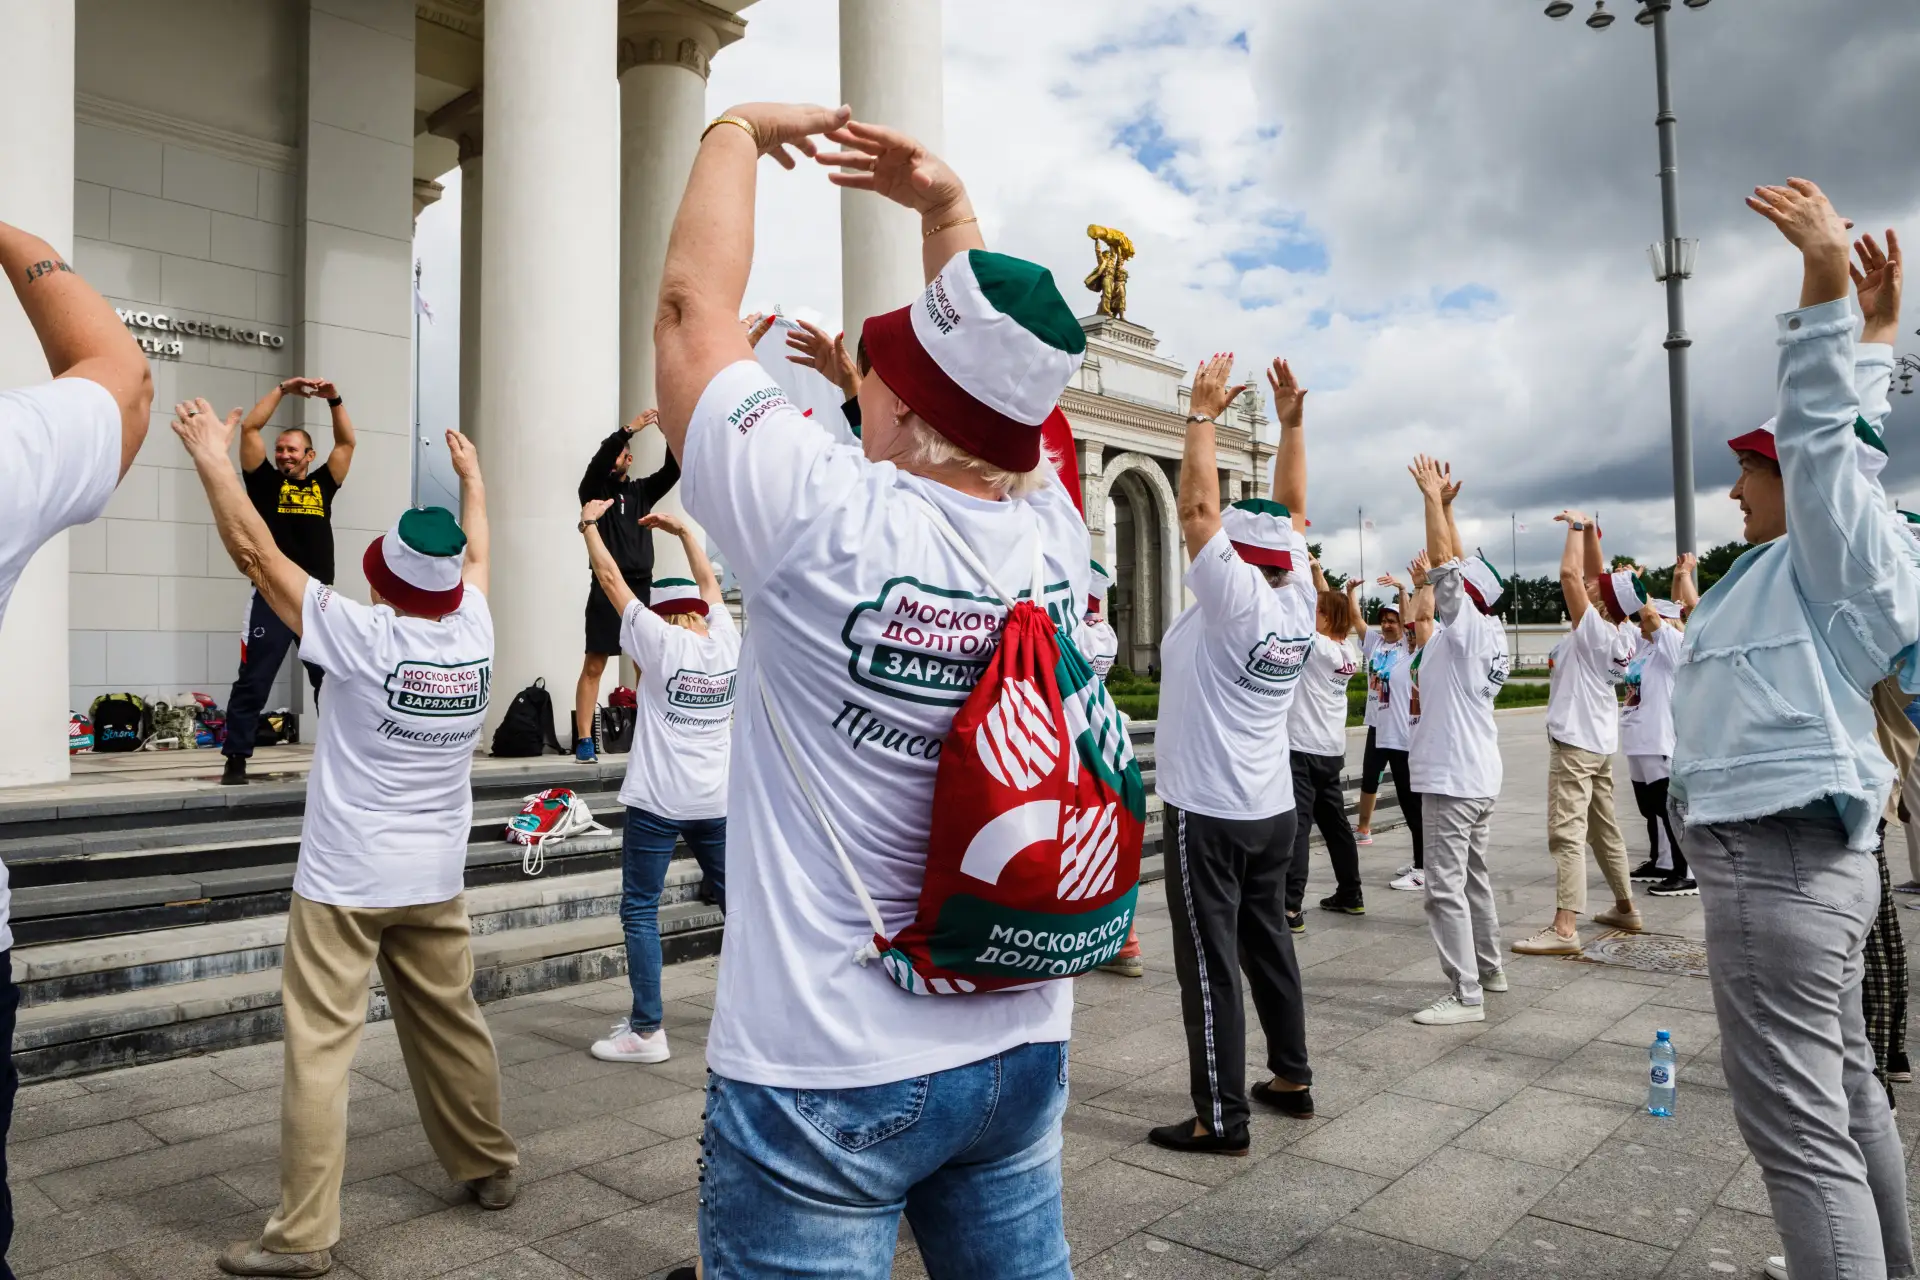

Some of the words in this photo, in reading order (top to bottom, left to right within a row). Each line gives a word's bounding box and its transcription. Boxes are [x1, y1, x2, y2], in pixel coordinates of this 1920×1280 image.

[935, 275, 961, 325] ОСКОВСКОЕ
[114, 307, 284, 348] МОСКОВСКОГО
[727, 387, 784, 425] ОЛГОЛЕТИЕ
[738, 397, 787, 435] СКОВСКОЕ
[402, 680, 479, 694] ДОЛГОЛЕТИЕ
[403, 670, 478, 682] МОСКОВСКОЕ
[884, 652, 979, 687] ЗАРЯЖ
[404, 694, 475, 709] ЗАРЯЖАЕТ
[678, 683, 728, 695] ДОЛГОЛЕТИЕ
[678, 693, 724, 704] ЗАРЯЖАЕТ
[831, 699, 942, 760] Присо
[988, 908, 1130, 953] МОСКОВСКОЕ
[975, 934, 1124, 976] ДОЛГОЛЕТИЕ
